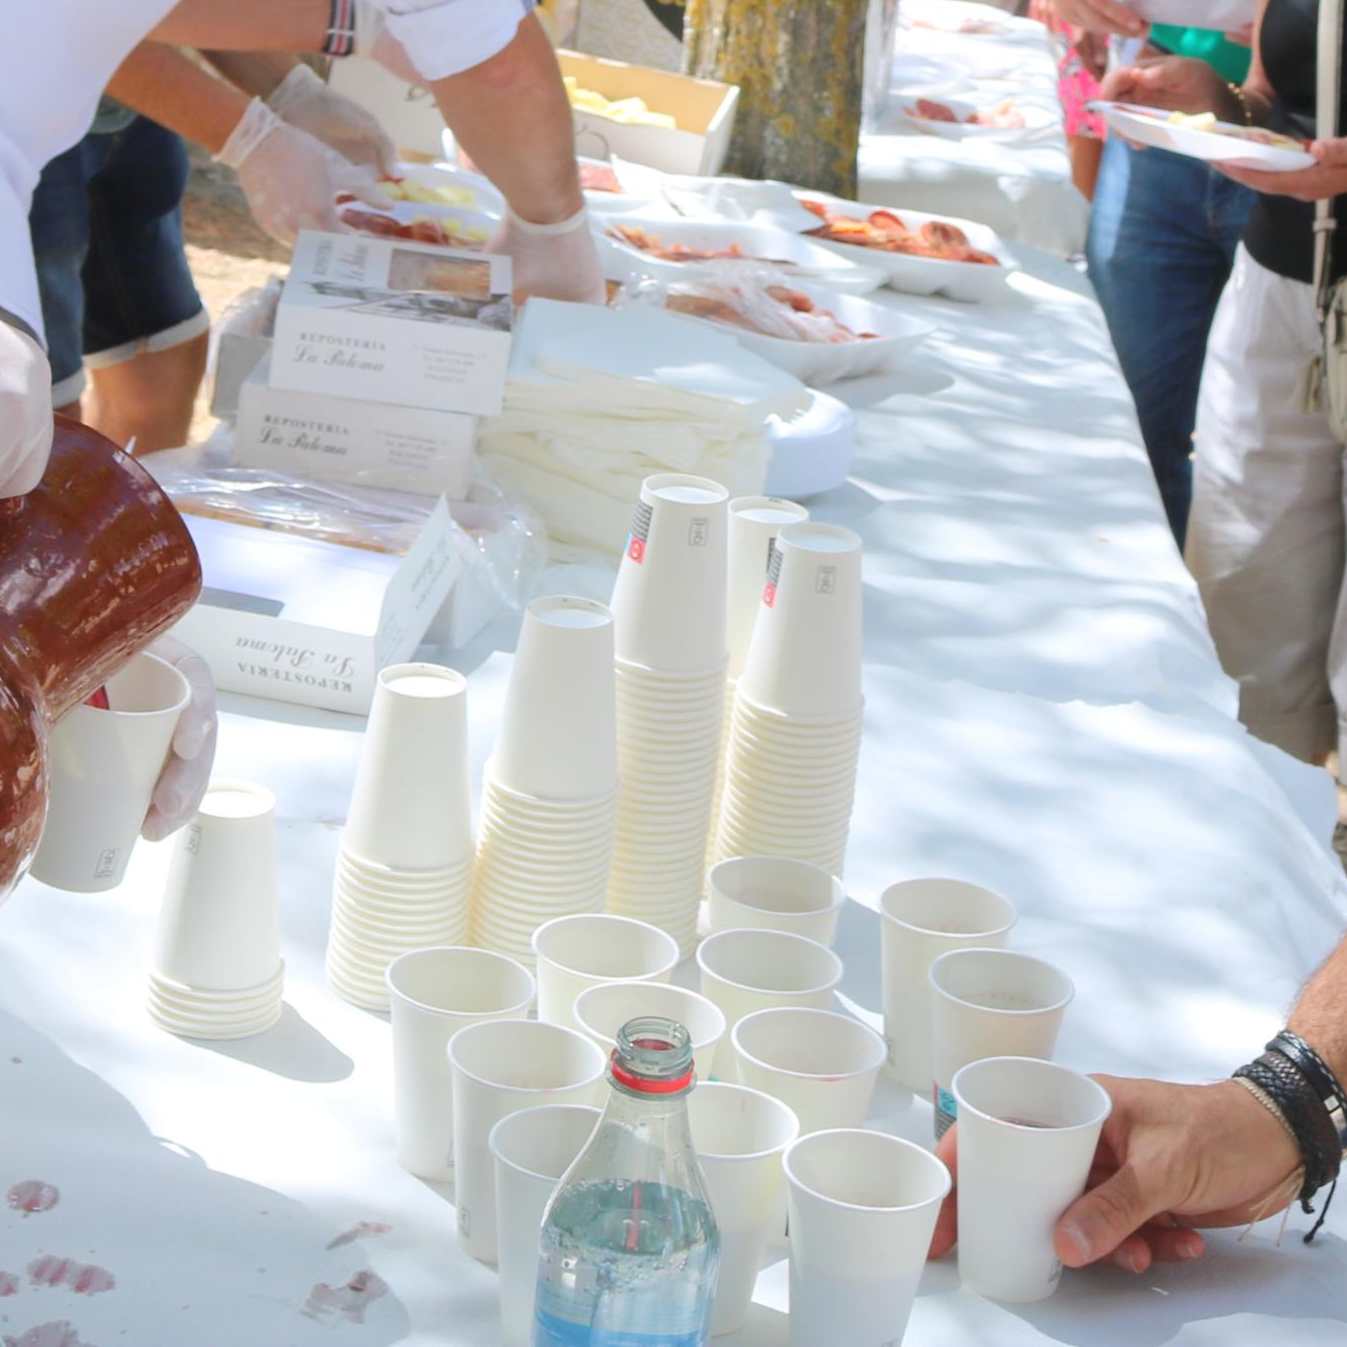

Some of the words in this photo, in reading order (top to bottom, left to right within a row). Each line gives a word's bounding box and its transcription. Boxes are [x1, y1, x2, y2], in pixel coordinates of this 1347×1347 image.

[235, 637, 316, 670] Paloma
[324, 652, 354, 679] La
[236, 661, 353, 693] REPOSTERIA
